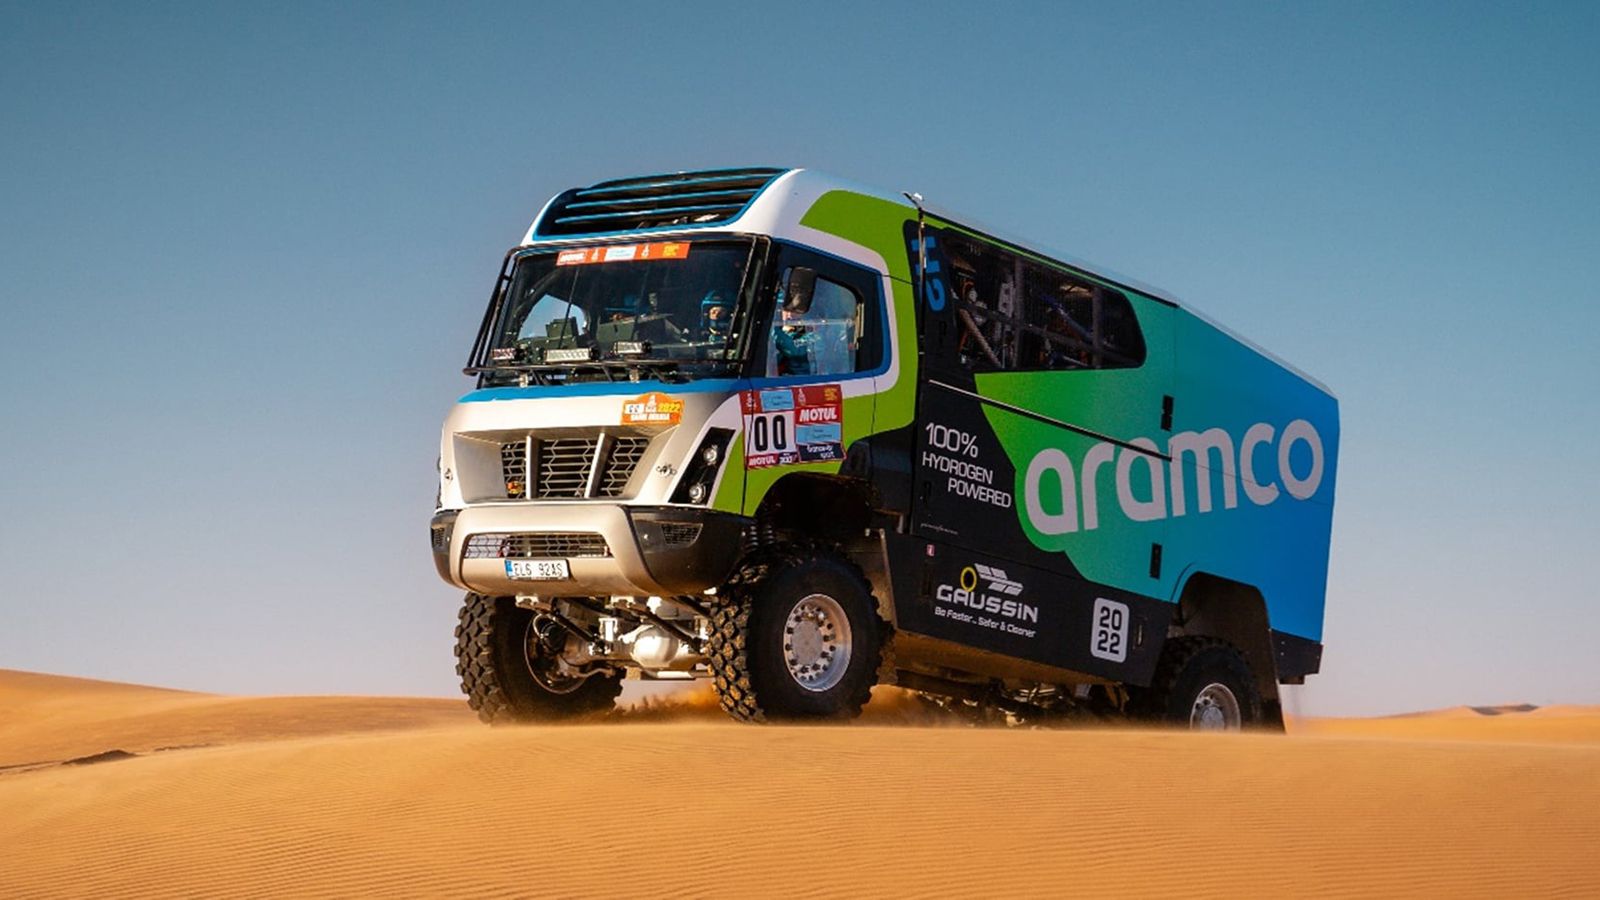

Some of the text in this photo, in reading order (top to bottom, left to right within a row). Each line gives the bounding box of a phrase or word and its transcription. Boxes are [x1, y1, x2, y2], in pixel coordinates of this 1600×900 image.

[800, 407, 837, 422] MOTUL
[754, 414, 787, 452] 00
[926, 422, 979, 458] 100%
[748, 456, 776, 466] MOTUL
[922, 451, 993, 485] HYDROGEN
[947, 477, 1012, 508] POWERED
[1024, 419, 1324, 535] aramco
[934, 606, 946, 617] Be
[978, 616, 1000, 629] Safer
[999, 621, 1006, 631] &
[1006, 623, 1037, 638] Cleaner
[1100, 606, 1122, 631] 20
[1097, 630, 1120, 655] 22
